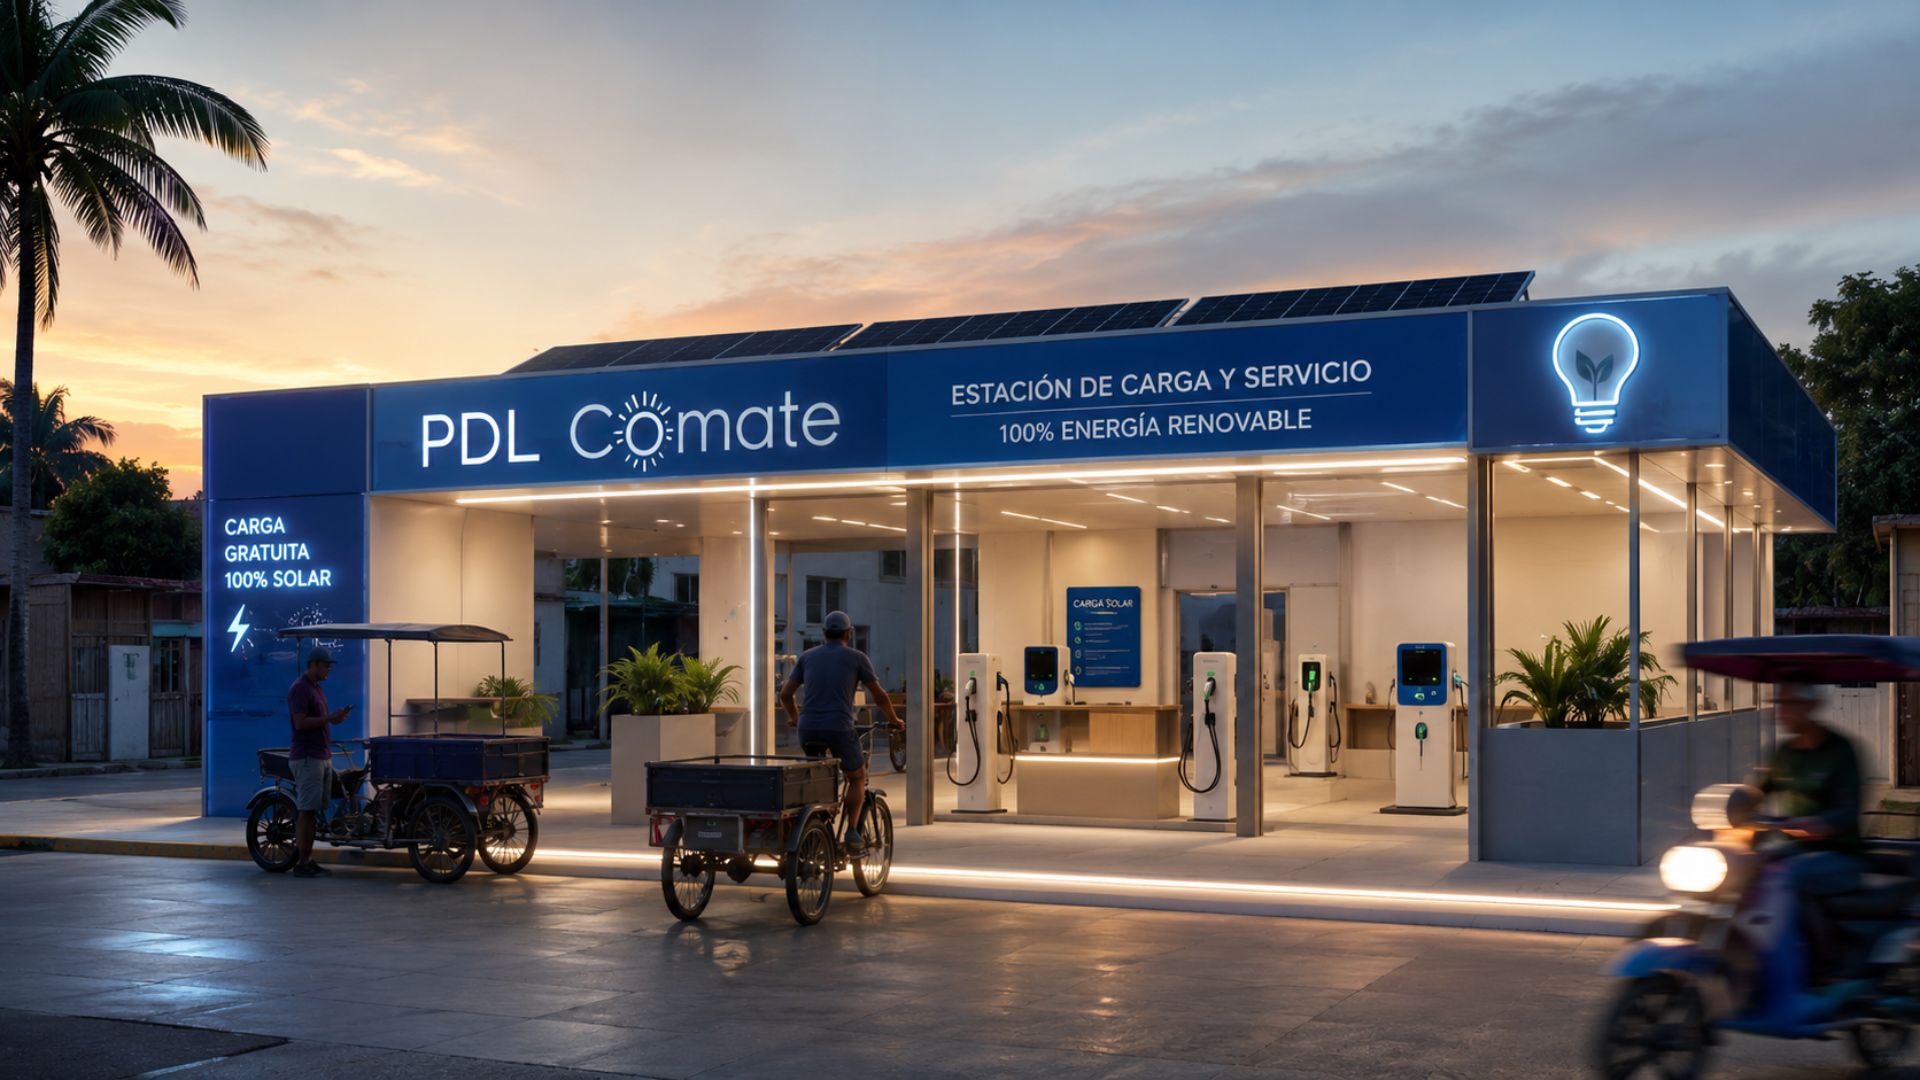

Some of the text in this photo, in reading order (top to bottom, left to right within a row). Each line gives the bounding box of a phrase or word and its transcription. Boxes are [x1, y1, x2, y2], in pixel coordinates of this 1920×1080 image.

[951, 359, 1373, 407] ESTACIÓN DE CARGA Y SERVICIO
[421, 390, 842, 468] PDL Comate
[998, 408, 1313, 444] 100% ENERGÍA RENOVABLE
[224, 516, 286, 536] CARGA
[224, 543, 311, 562] GRATUITA
[224, 569, 332, 588] 100% SOLAR
[1073, 599, 1104, 608] CARGA
